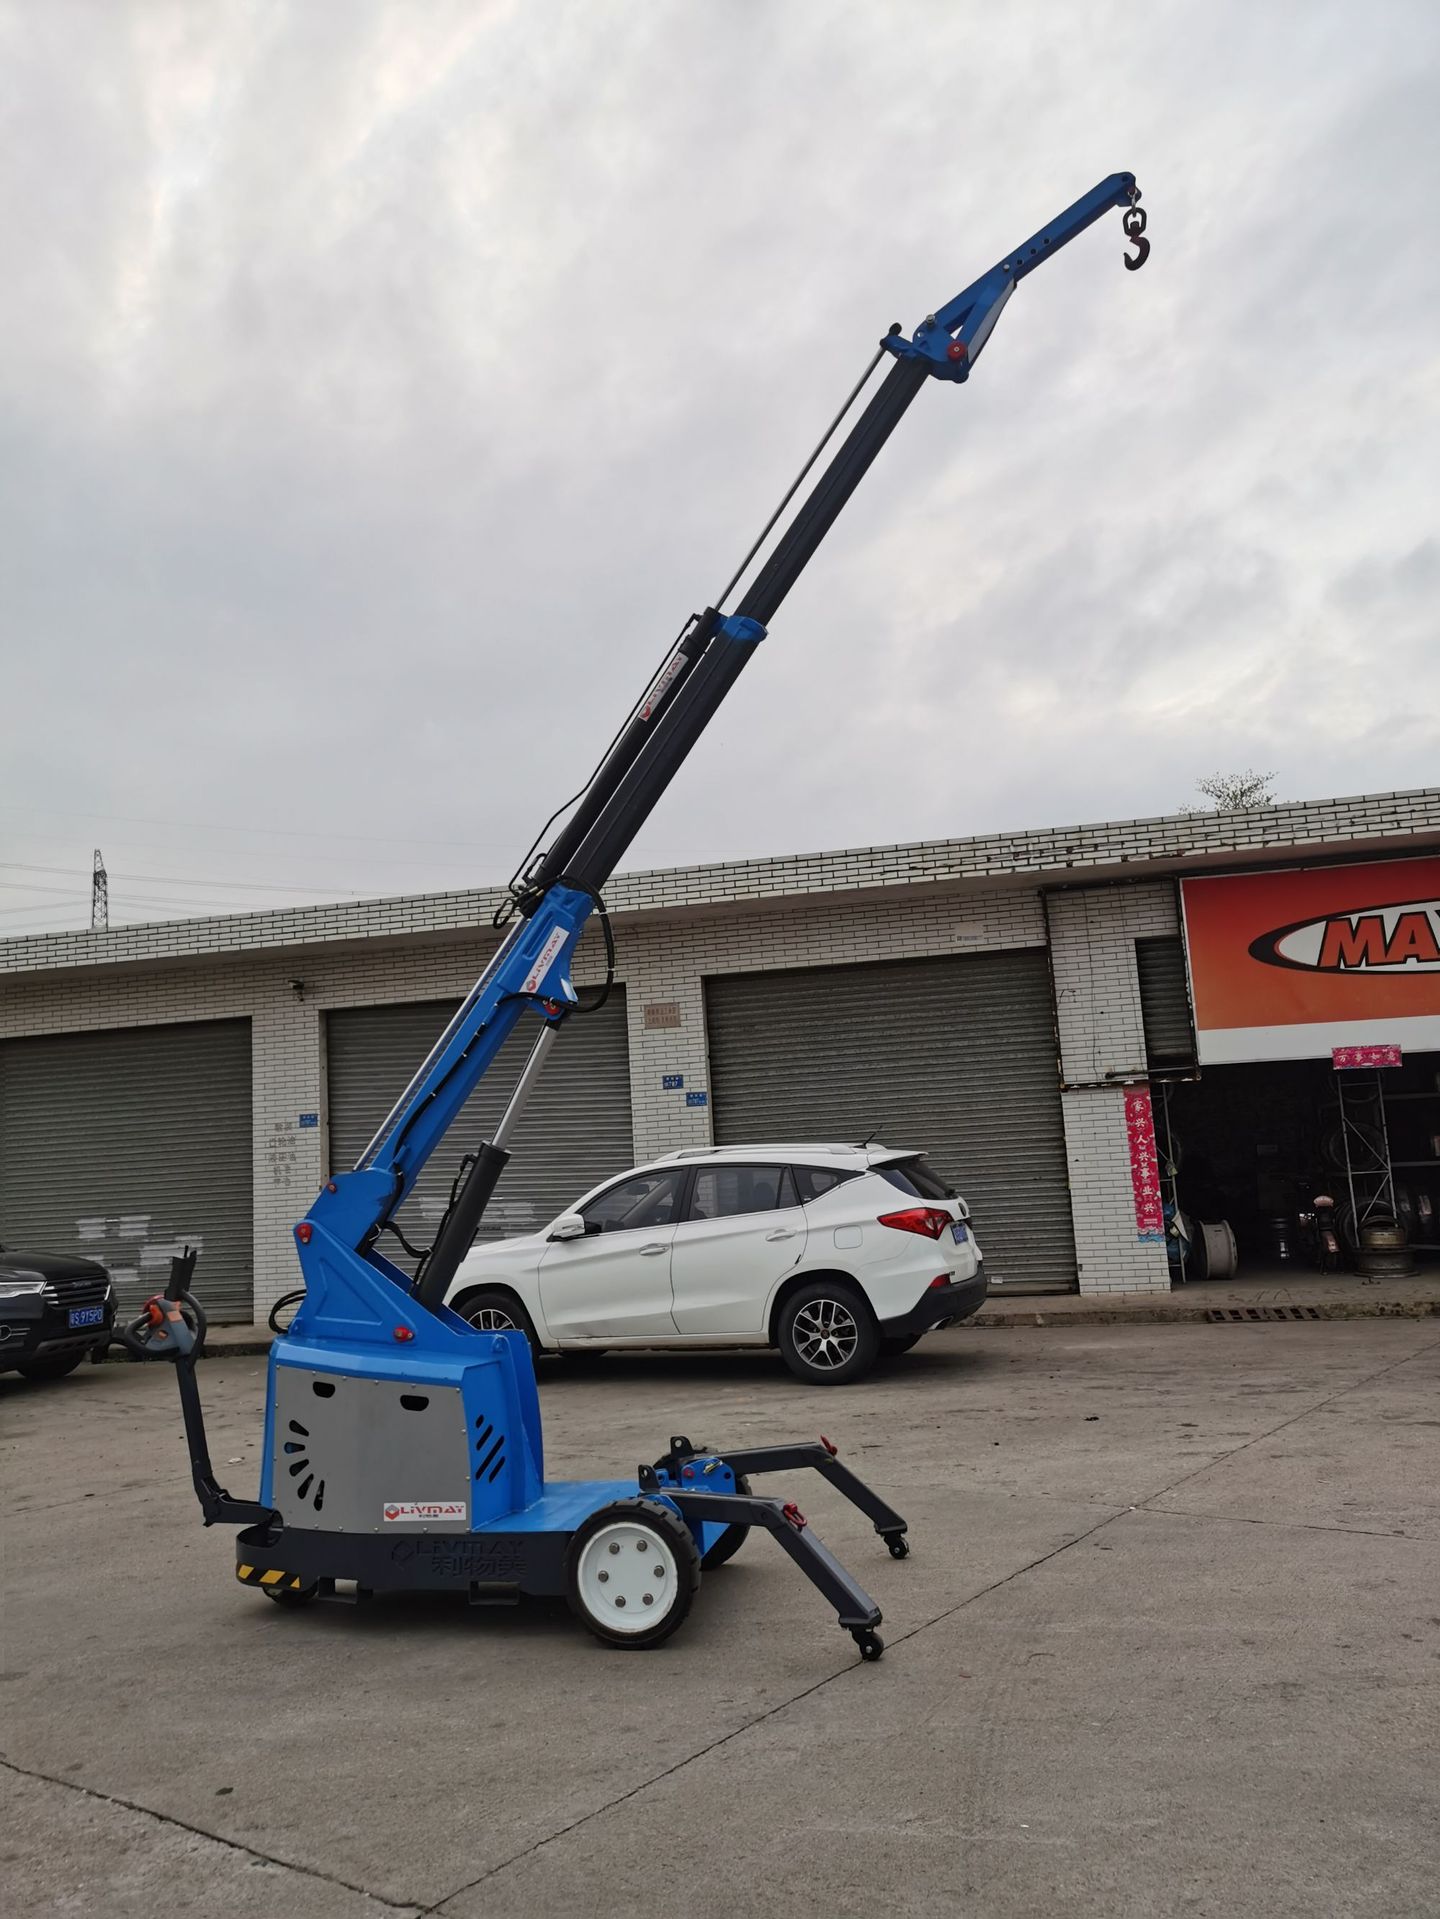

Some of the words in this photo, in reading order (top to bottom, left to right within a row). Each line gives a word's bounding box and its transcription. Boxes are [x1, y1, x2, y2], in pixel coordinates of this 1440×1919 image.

[1316, 909, 1440, 969] MA
[1131, 1098, 1156, 1215] 家兴人兴事业兴
[431, 1555, 529, 1577] 利物美
